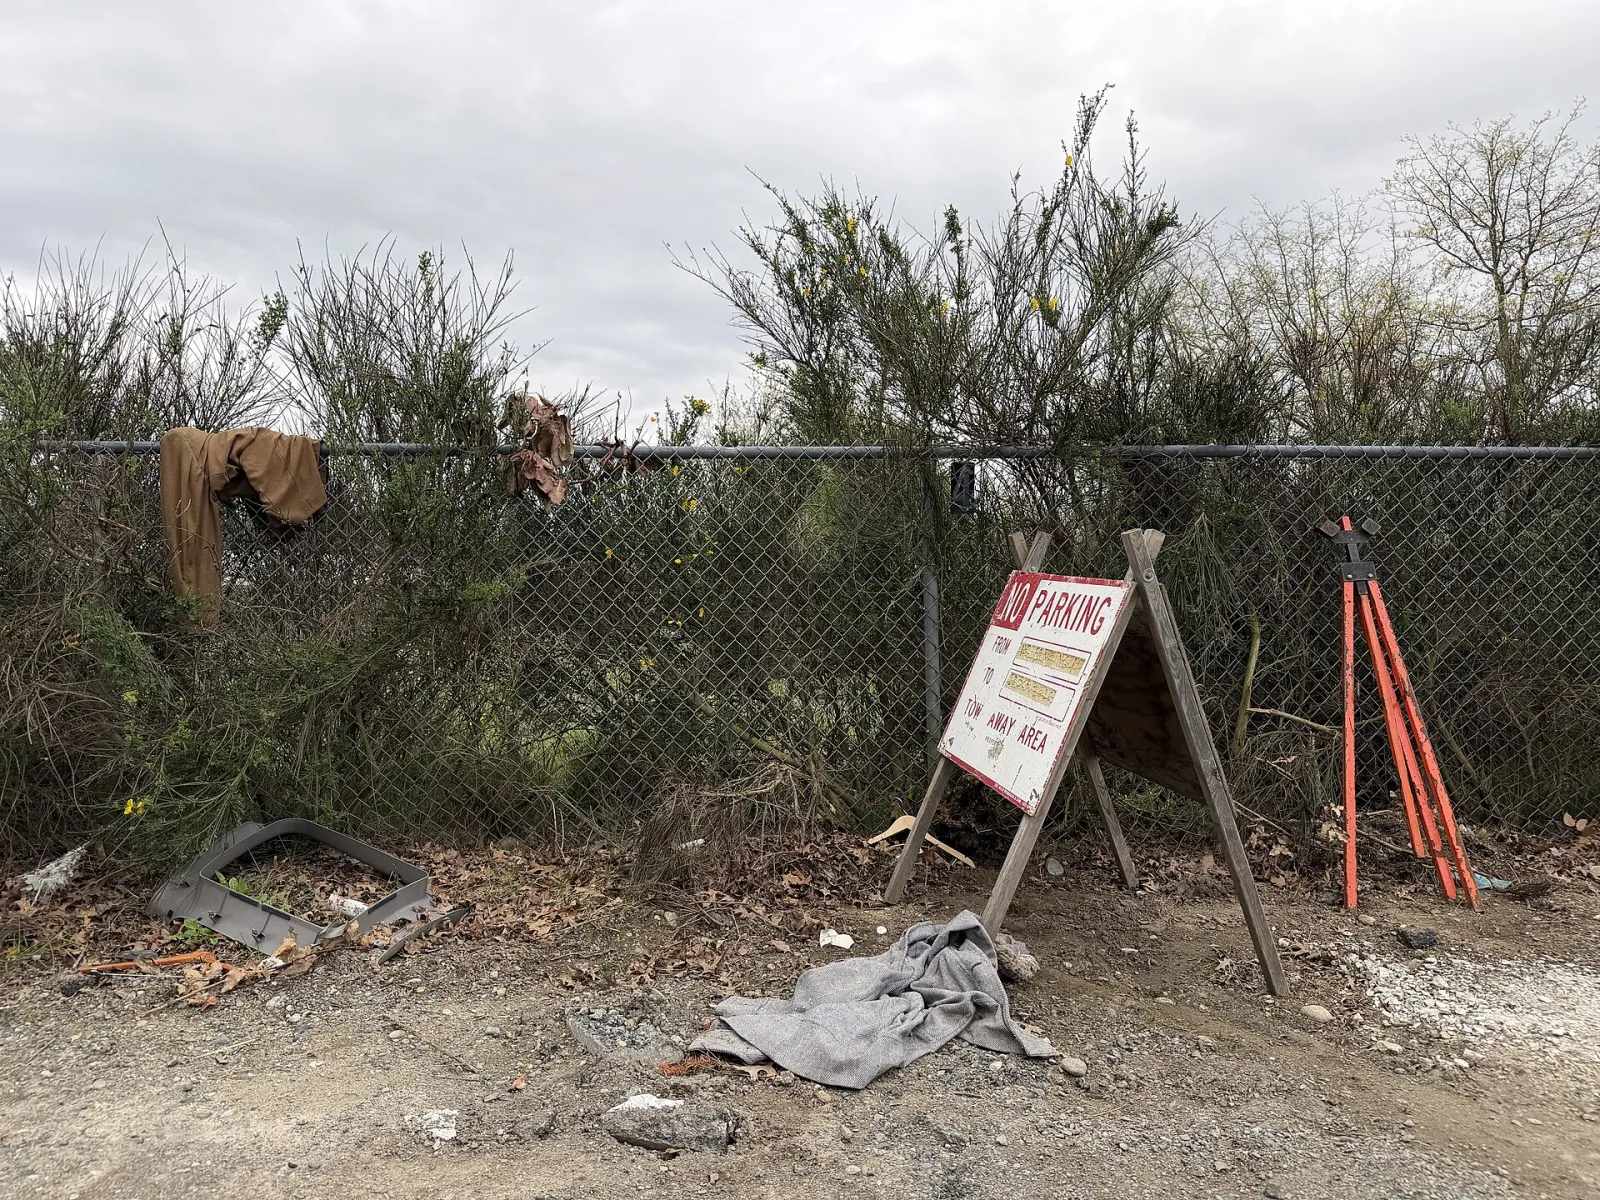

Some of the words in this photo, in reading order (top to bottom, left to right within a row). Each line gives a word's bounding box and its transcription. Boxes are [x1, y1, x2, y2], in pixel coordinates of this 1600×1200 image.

[1000, 582, 1031, 623] NO
[1027, 589, 1112, 636] PARKING
[991, 635, 1012, 655] FROM
[983, 667, 995, 685] TO
[963, 698, 984, 720] TOW
[986, 711, 1017, 737] AWAY
[1017, 724, 1048, 755] AREA
